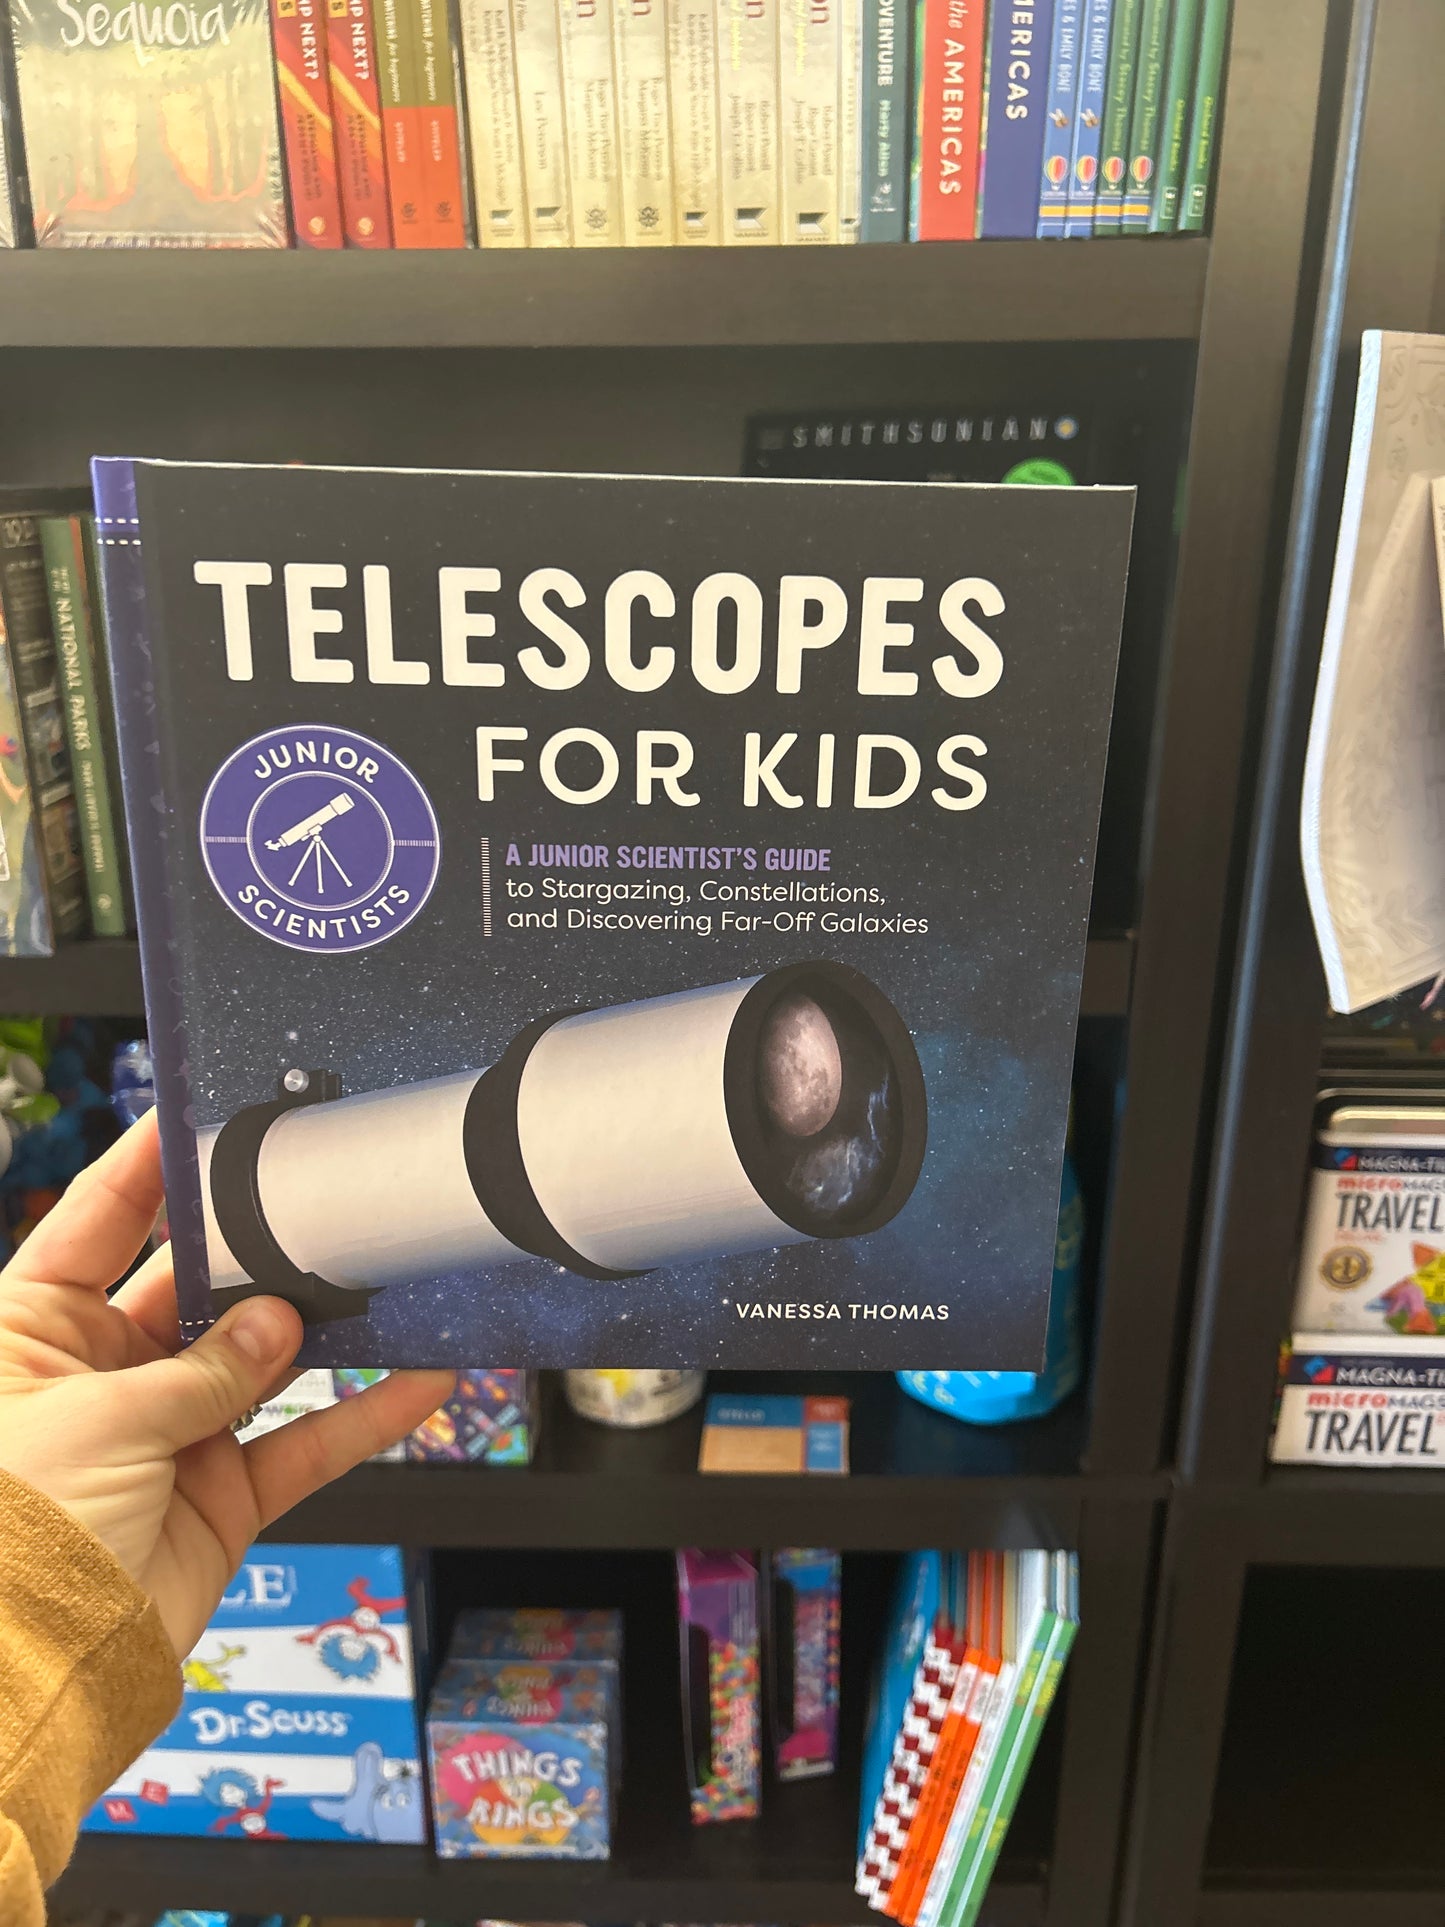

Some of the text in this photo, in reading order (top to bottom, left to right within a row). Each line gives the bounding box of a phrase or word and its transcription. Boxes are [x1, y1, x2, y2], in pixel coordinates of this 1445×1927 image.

[57, 0, 230, 67] Sequoia
[301, 22, 318, 80] NEXT?
[351, 22, 369, 80] NEXT?
[1059, 28, 1075, 60] EMILY
[1090, 28, 1106, 60] EMILY
[939, 0, 968, 195] the AMERICAS
[1056, 63, 1073, 93] BONE
[1087, 63, 1104, 93] BONE
[1113, 63, 1132, 103] Stacey
[1143, 62, 1161, 103] Stacey
[877, 99, 891, 139] Marty
[1112, 106, 1128, 151] Thomas
[1140, 105, 1157, 151] Thomas
[877, 142, 891, 177] Allen
[792, 417, 1047, 447] SMITHSONIAN
[55, 597, 83, 689] NATIONAL
[194, 561, 1006, 698] TELESCOPES
[68, 694, 93, 752] PARKS
[254, 741, 380, 784] JUNIOR
[476, 726, 989, 811] FOR KIDS
[505, 844, 831, 871] A JUNIOR SCIENTIST'S GUIDE
[237, 884, 410, 939] SCIENTISTS
[506, 878, 886, 906] to Stargazing, Constellations,
[507, 908, 929, 936] and Discovering Far-Off Galaxies
[1336, 1192, 1445, 1232] TRAVEL
[735, 1303, 950, 1321] VANESSA THOMAS
[1305, 1410, 1437, 1455] TRAVEL
[244, 1699, 350, 1739] Seuss
[451, 1748, 583, 1788] THINGS
[465, 1797, 580, 1829] RINGS
